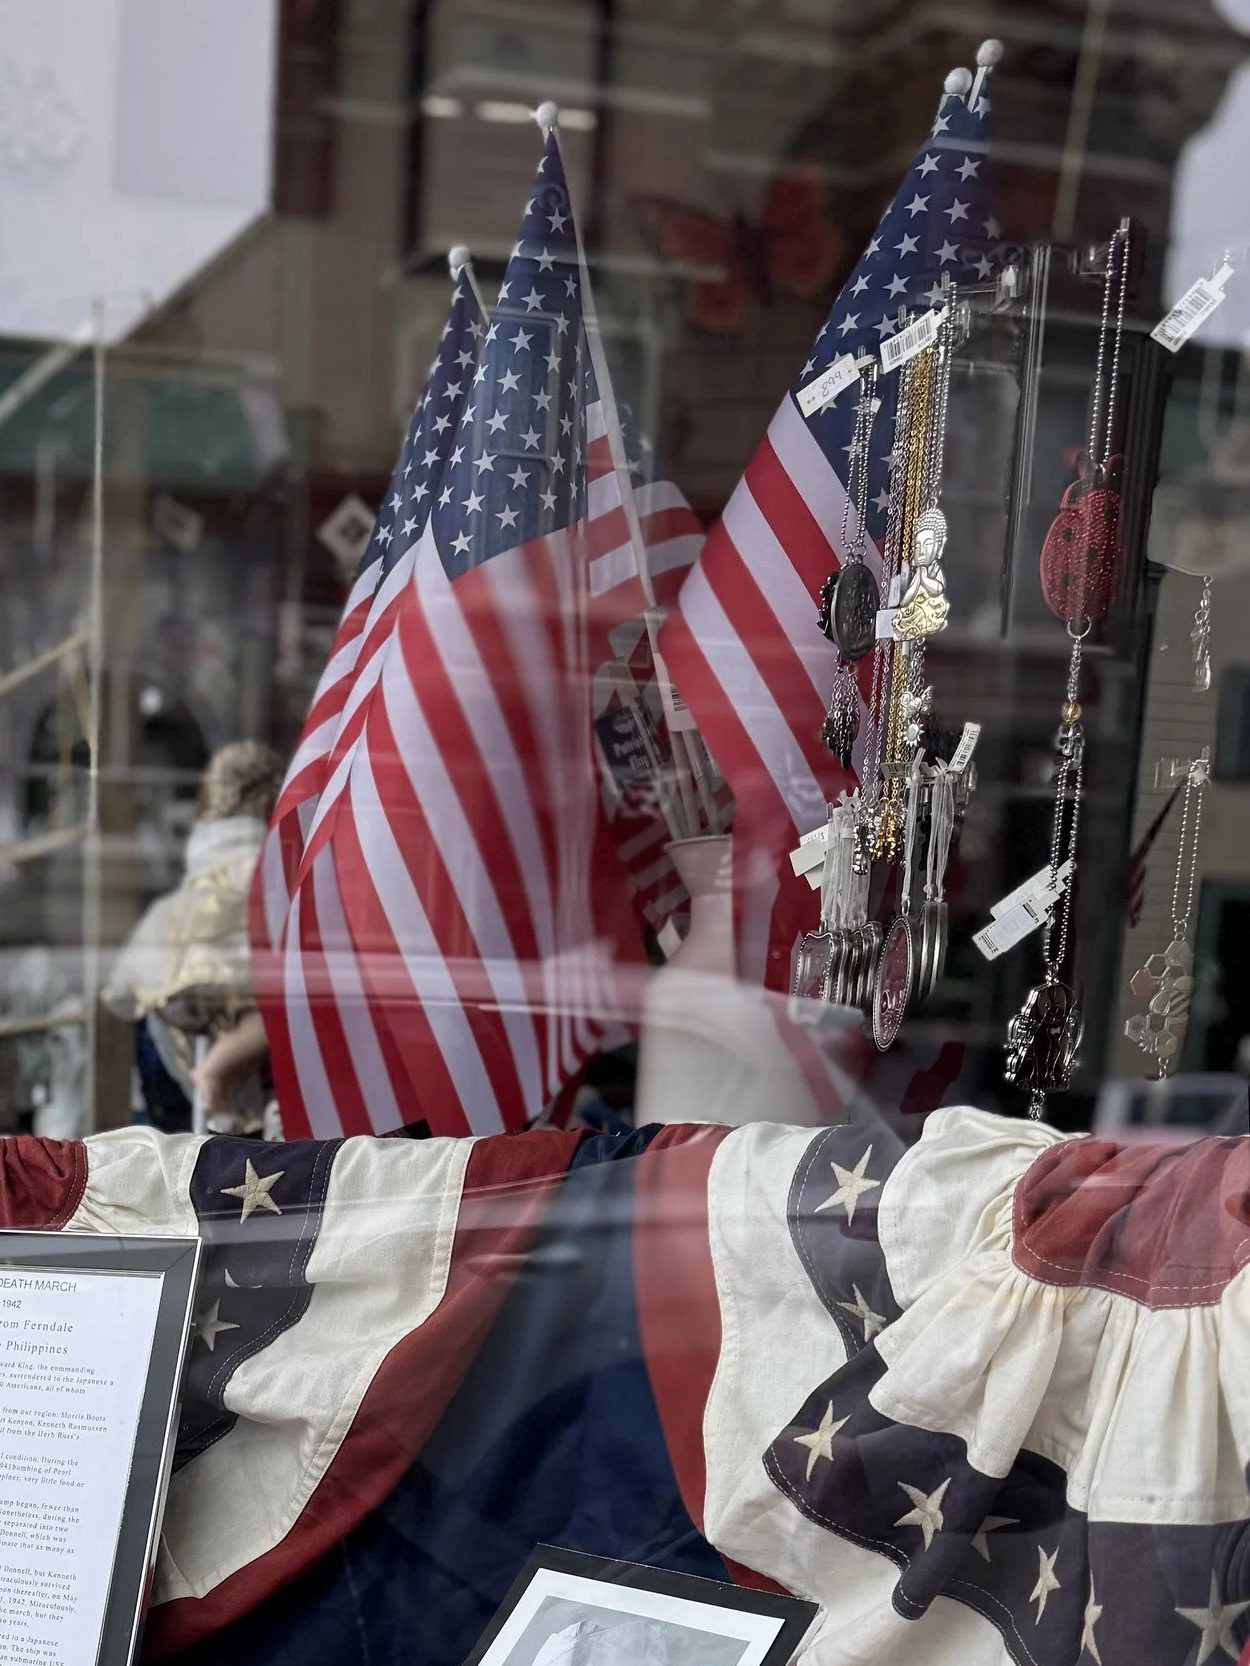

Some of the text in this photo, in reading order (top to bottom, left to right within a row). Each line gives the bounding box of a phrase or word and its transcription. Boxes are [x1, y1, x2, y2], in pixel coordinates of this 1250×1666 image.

[35, 1280, 76, 1292] MARCH
[3, 1300, 21, 1308] 1942
[24, 1320, 73, 1332] Ferndale
[6, 1341, 68, 1355] Philippines
[50, 1364, 95, 1375] commanding
[10, 1371, 51, 1380] surrendered
[76, 1376, 107, 1386] Japanese
[65, 1385, 86, 1393] whom
[30, 1532, 50, 1540] which
[40, 1580, 70, 1590] survived
[62, 1593, 78, 1603] May
